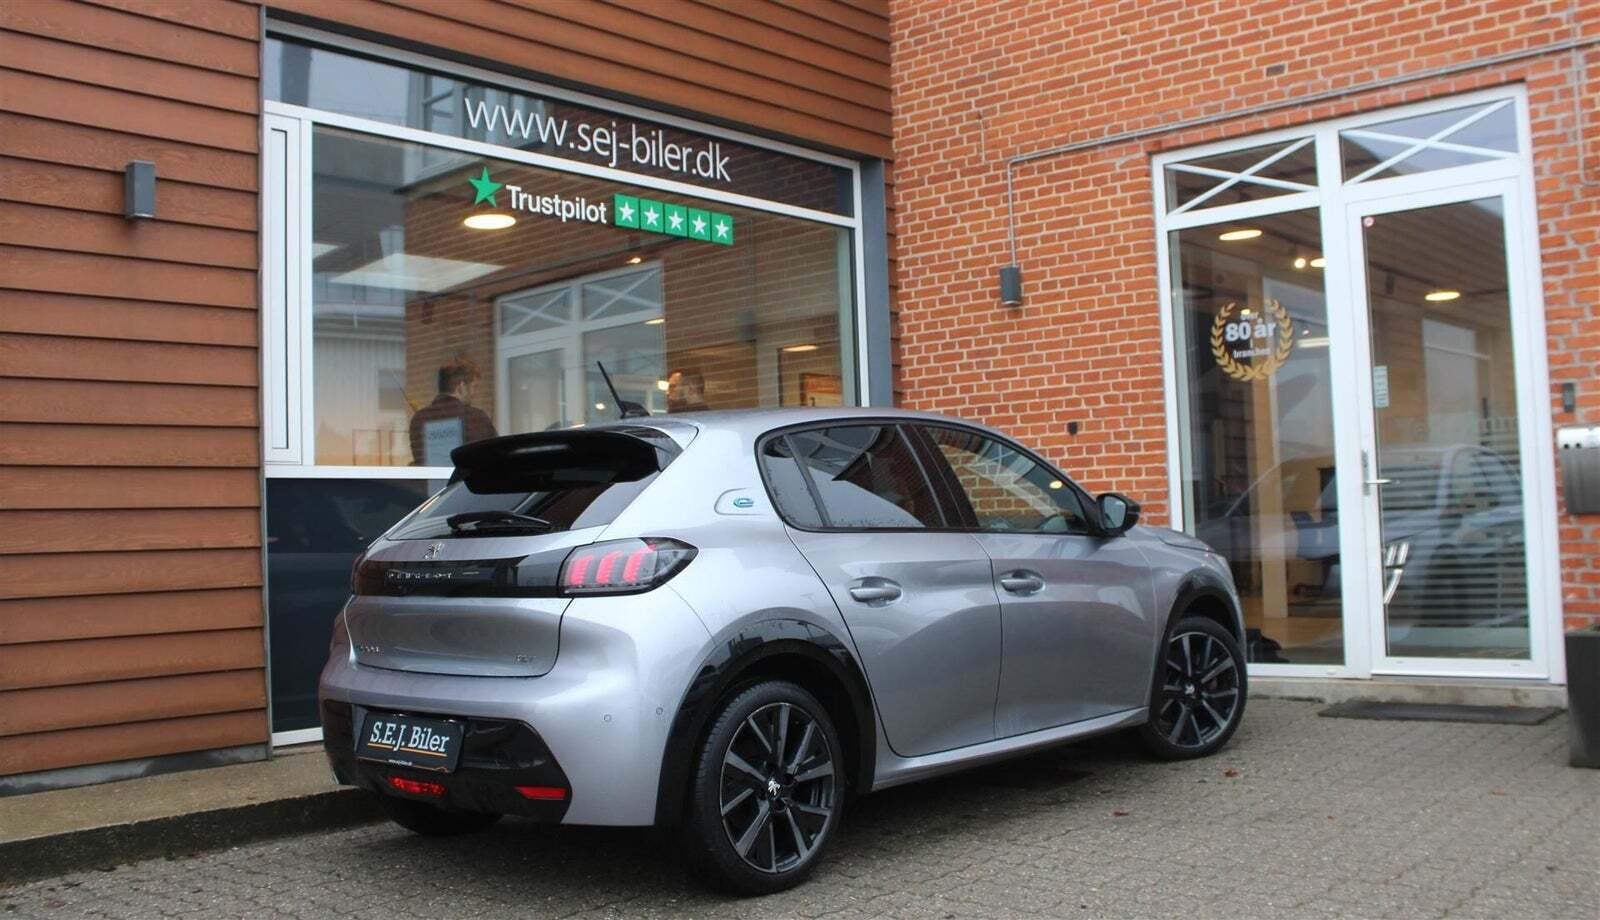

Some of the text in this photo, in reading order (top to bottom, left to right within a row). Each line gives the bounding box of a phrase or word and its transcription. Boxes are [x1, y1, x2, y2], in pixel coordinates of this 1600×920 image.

[464, 97, 732, 182] www.sej-biler.dk
[506, 184, 607, 224] Trustpilot
[1225, 317, 1276, 342] 80 år
[369, 721, 450, 752] S.E.J. Biler
